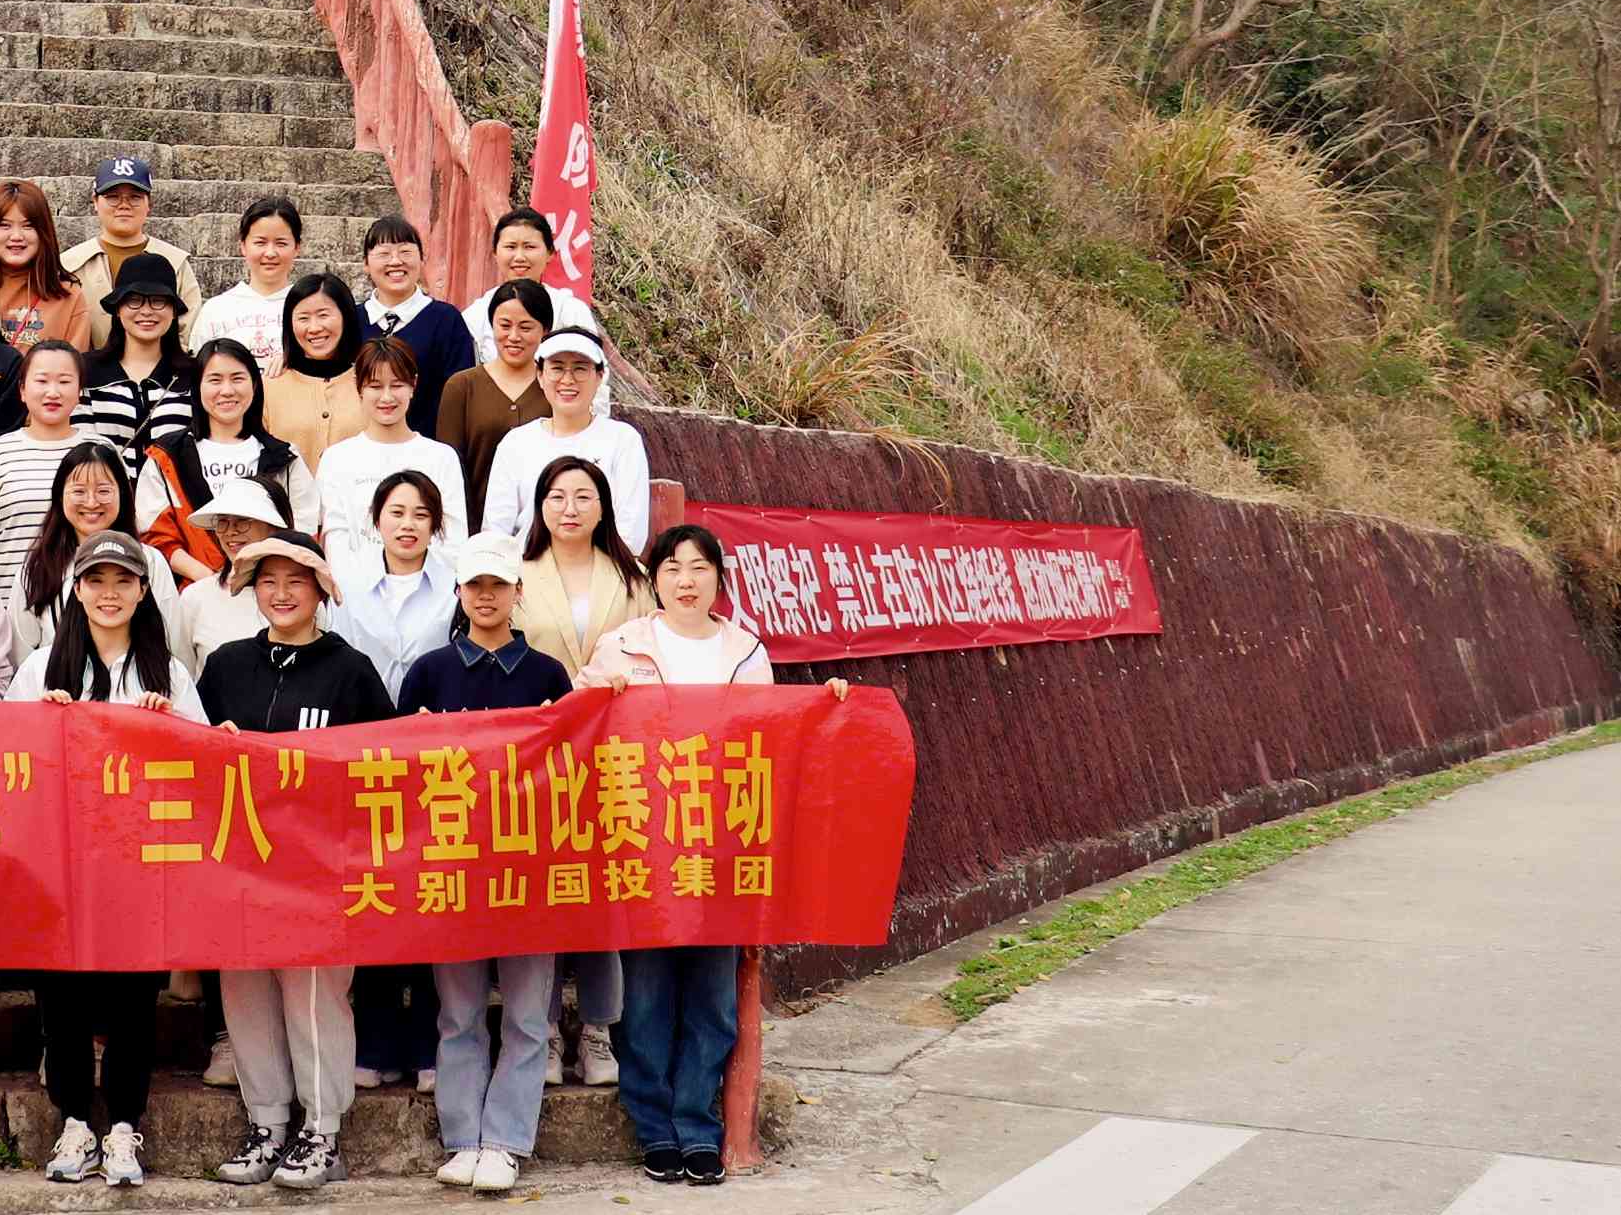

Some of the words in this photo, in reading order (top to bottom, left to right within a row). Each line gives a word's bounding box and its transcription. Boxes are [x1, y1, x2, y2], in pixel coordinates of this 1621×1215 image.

[718, 539, 832, 637] 文明祭祀
[822, 543, 1023, 632] 禁止在防火区烧纸钱
[341, 854, 773, 918] 大别山国投集团
